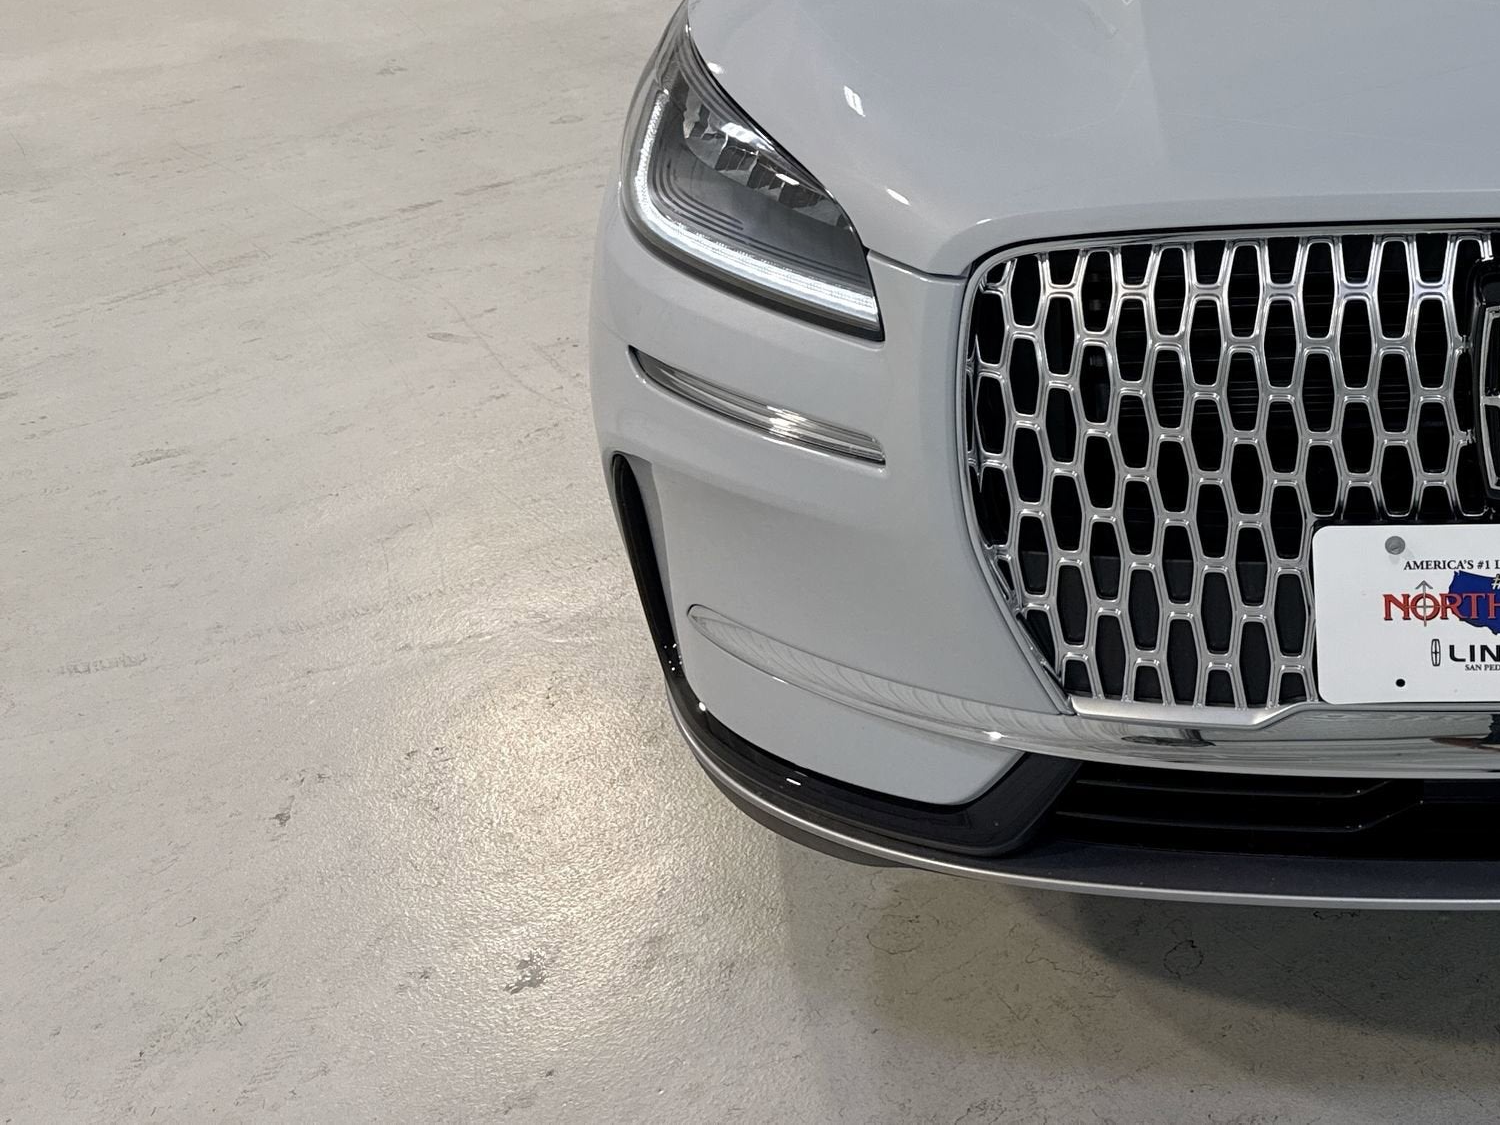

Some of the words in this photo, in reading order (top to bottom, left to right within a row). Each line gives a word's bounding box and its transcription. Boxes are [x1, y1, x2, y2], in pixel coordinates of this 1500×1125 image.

[1404, 559, 1474, 571] AMERICA'S
[1477, 559, 1491, 570] #1
[1464, 663, 1482, 671] SAN
